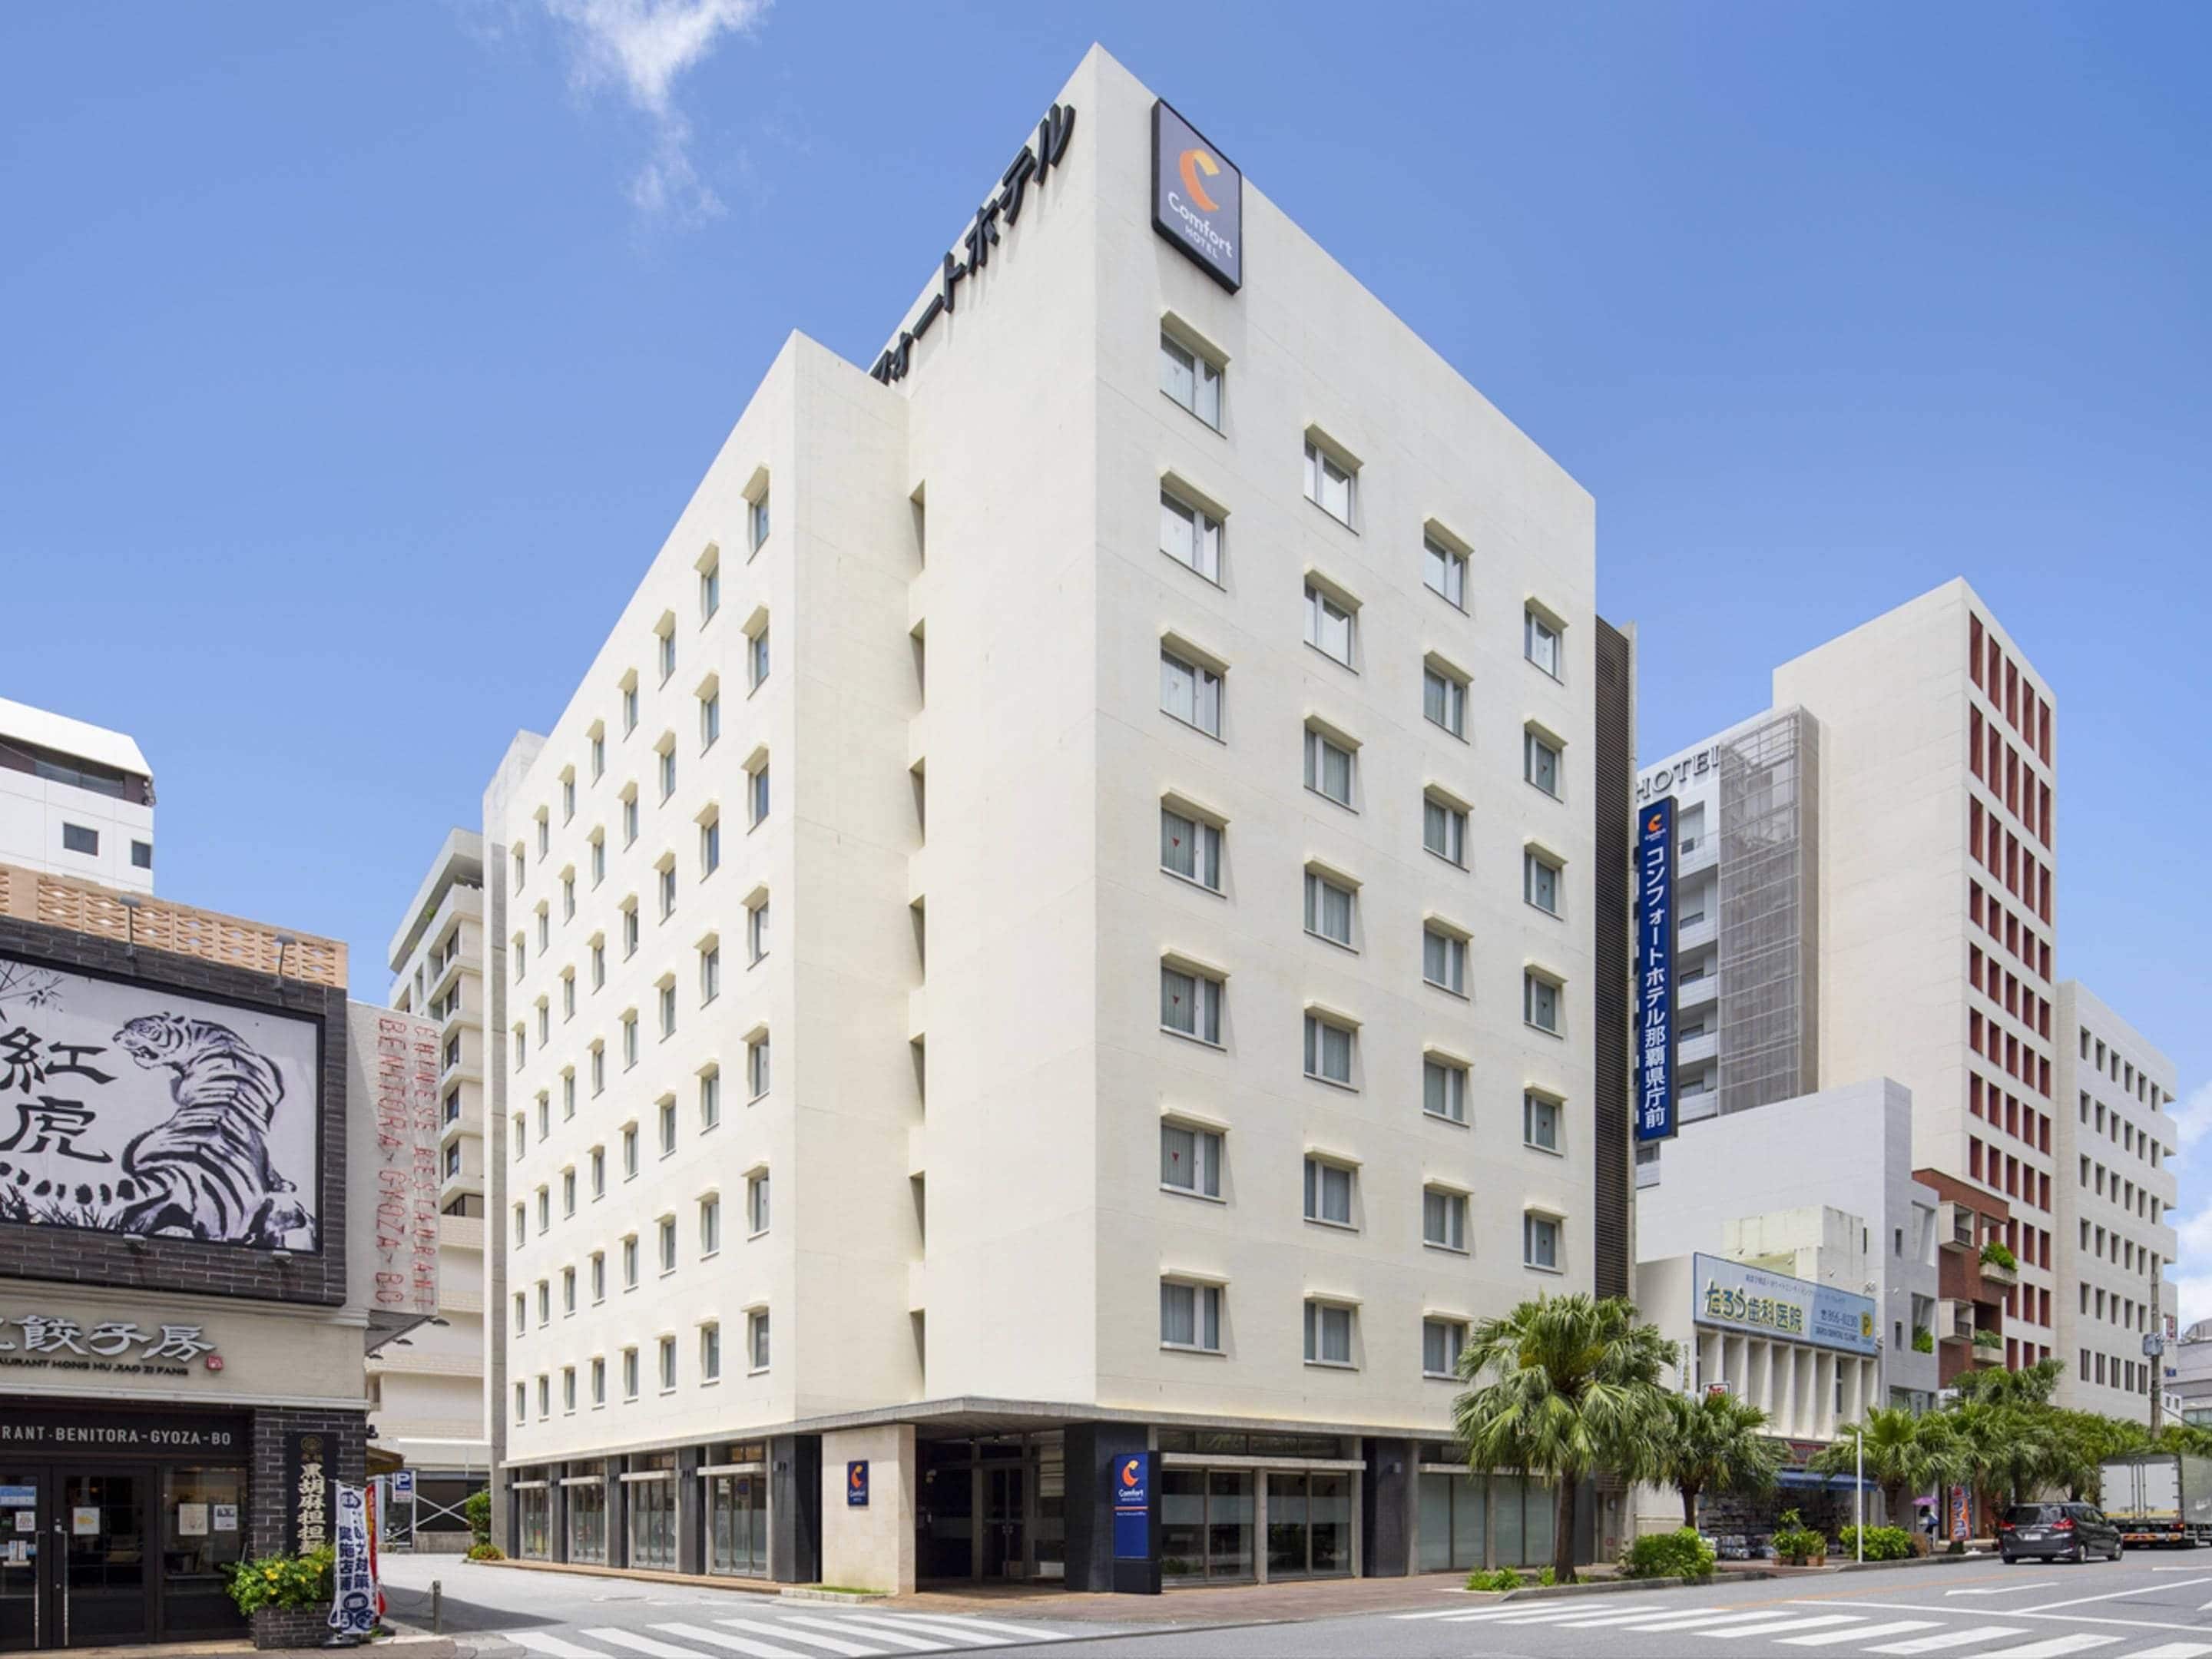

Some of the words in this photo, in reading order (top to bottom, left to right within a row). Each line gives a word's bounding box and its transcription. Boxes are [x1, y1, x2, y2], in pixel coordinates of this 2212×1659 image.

[1167, 191, 1233, 258] Comfort
[1185, 224, 1218, 258] HOTEL
[1644, 846, 1665, 1129] コンフォートホテル那覇県庁前
[413, 1025, 439, 1131] CHINESE
[412, 1147, 438, 1306] RESTAURANT
[0, 1314, 217, 1363] 餃子房
[52, 1359, 90, 1369] HONG
[93, 1363, 111, 1371] HU
[114, 1364, 140, 1373] JIAO
[144, 1366, 154, 1375] ZI
[157, 1367, 188, 1376] FANG
[396, 1473, 410, 1485] P
